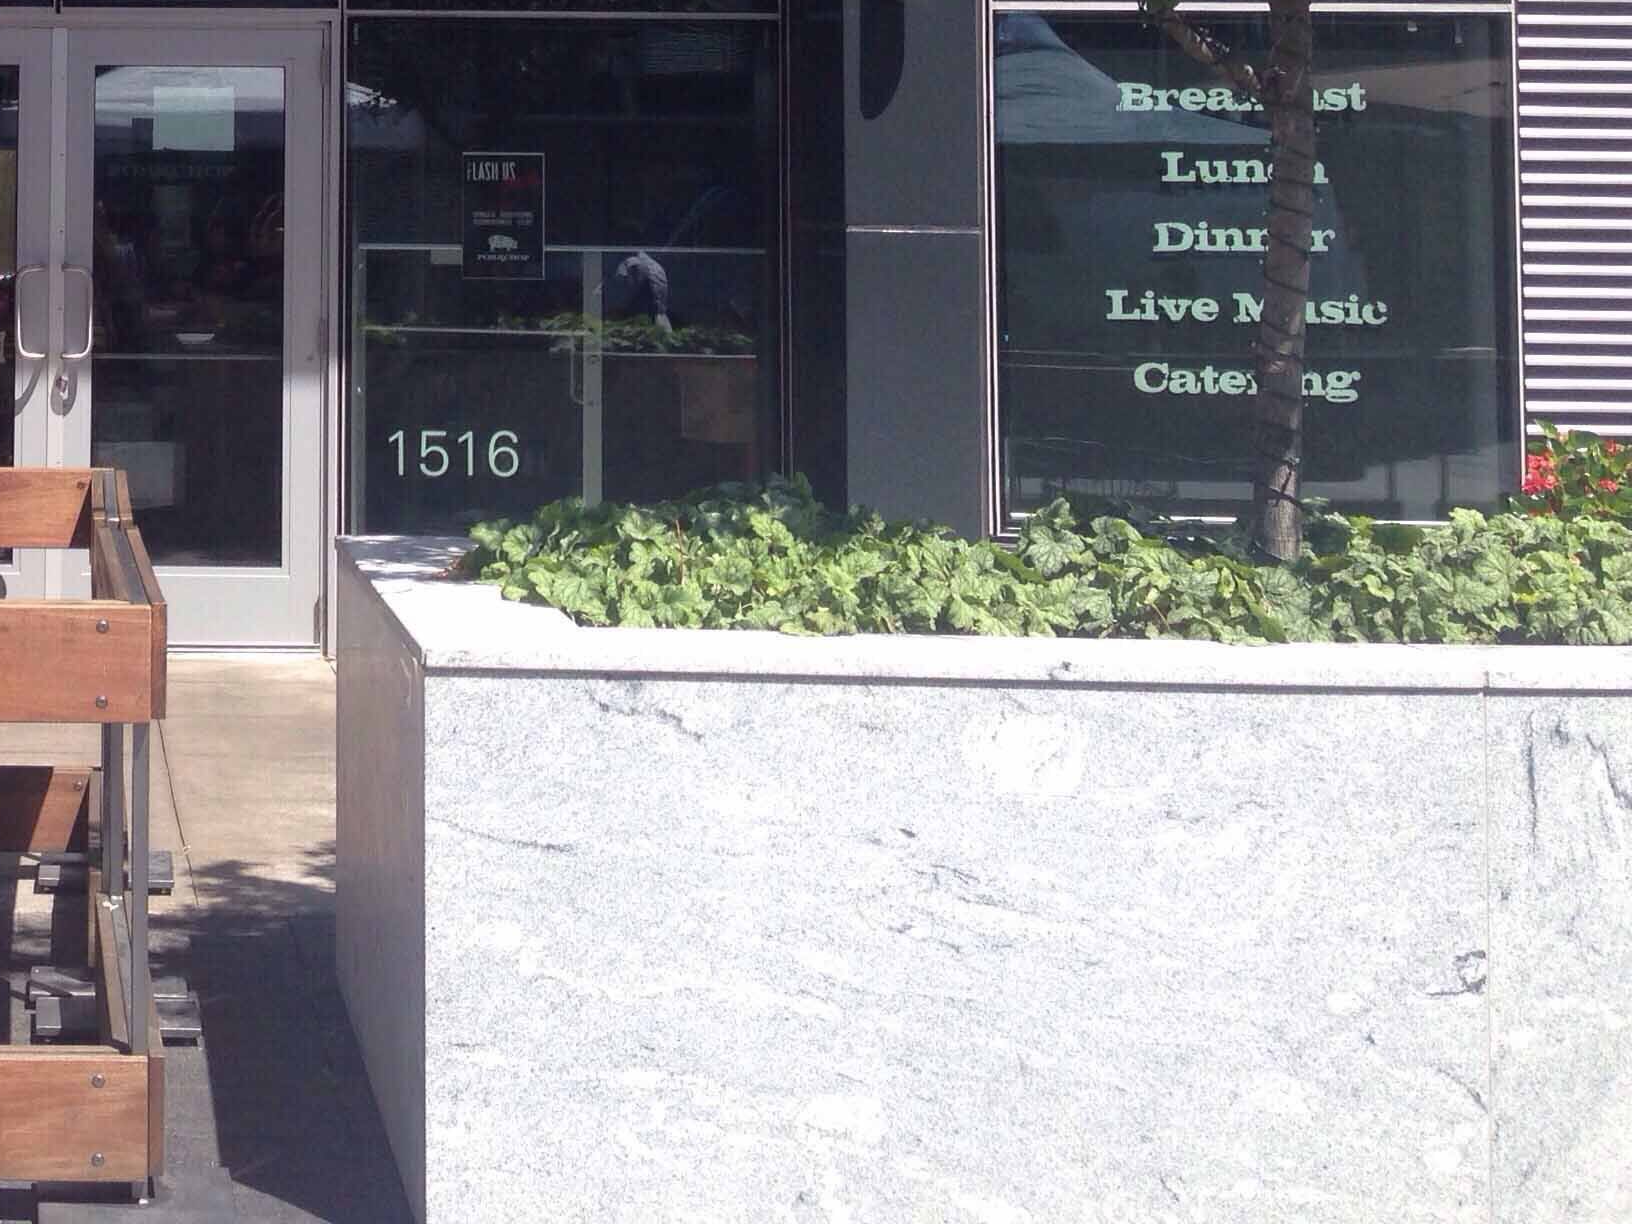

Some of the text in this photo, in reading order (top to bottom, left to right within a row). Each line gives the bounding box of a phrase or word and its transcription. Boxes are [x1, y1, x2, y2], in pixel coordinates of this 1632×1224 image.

[1116, 82, 1367, 112] Breast
[1152, 221, 1336, 253] Dinnr
[1105, 289, 1219, 322] Live
[388, 430, 519, 477] 1516
